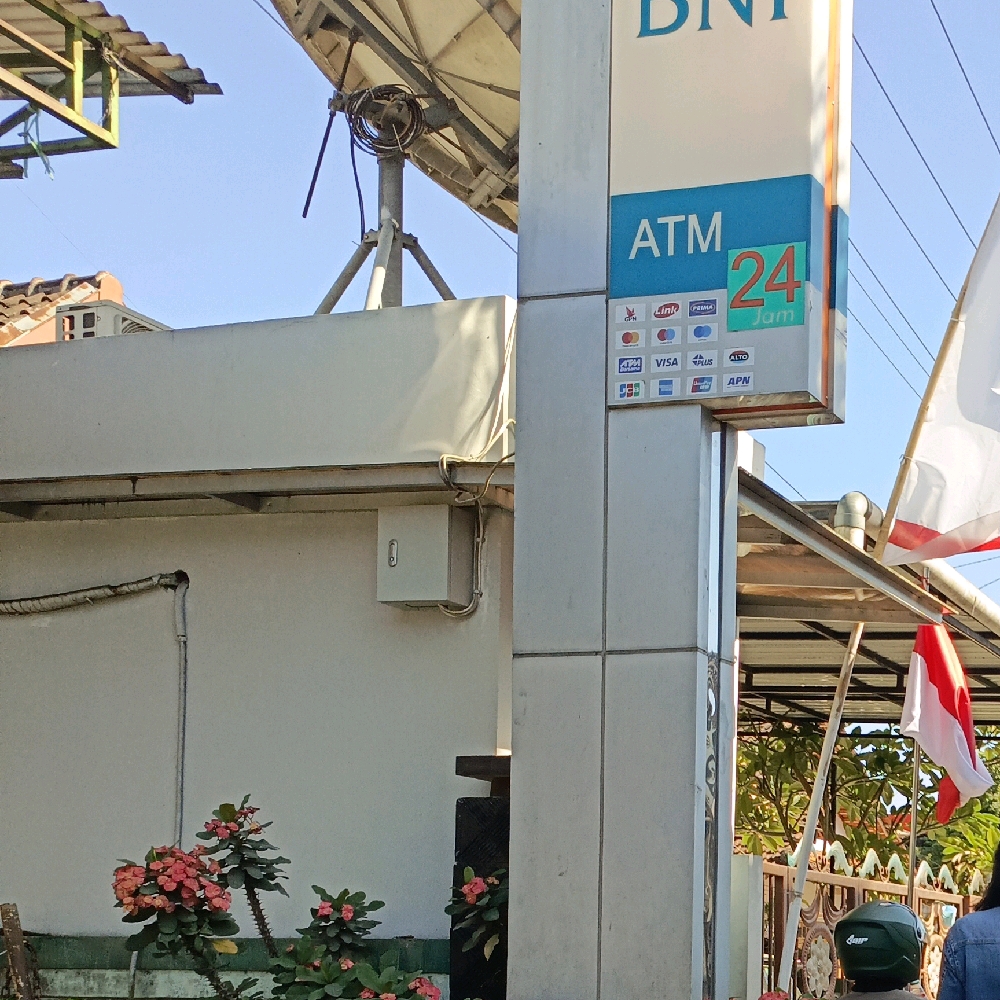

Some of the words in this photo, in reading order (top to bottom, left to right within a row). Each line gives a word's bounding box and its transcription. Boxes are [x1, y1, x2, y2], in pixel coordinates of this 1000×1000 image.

[628, 211, 722, 260] ATM
[729, 245, 802, 309] 24
[655, 305, 678, 315] Link
[752, 309, 795, 326] Jam
[655, 357, 679, 368] VISA
[697, 358, 713, 366] PLUS
[726, 376, 751, 386] APN
[619, 385, 640, 396] JCB
